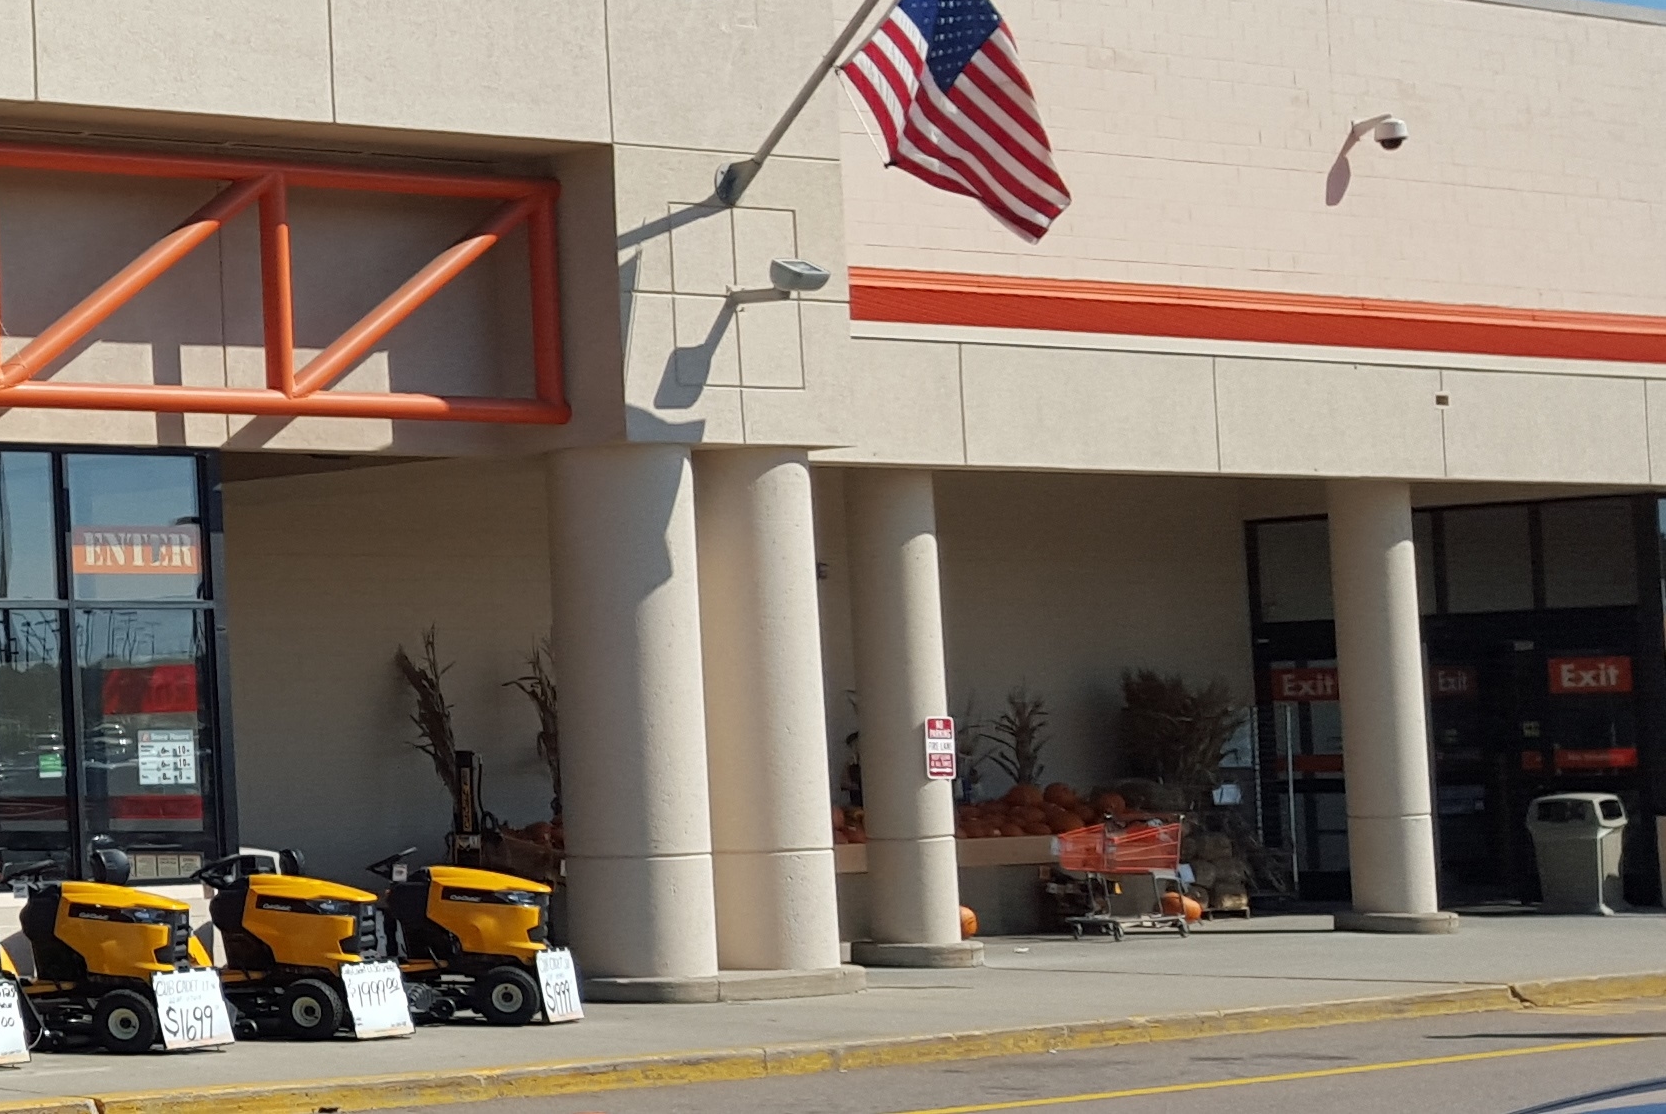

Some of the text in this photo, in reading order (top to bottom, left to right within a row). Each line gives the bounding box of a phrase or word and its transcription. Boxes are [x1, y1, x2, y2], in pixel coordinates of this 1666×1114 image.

[83, 532, 193, 567] ENTER
[1281, 672, 1337, 697] Exit
[1437, 670, 1468, 691] Exit
[1559, 663, 1620, 688] Exit
[176, 979, 198, 994] CADET
[164, 1006, 214, 1041] $1699
